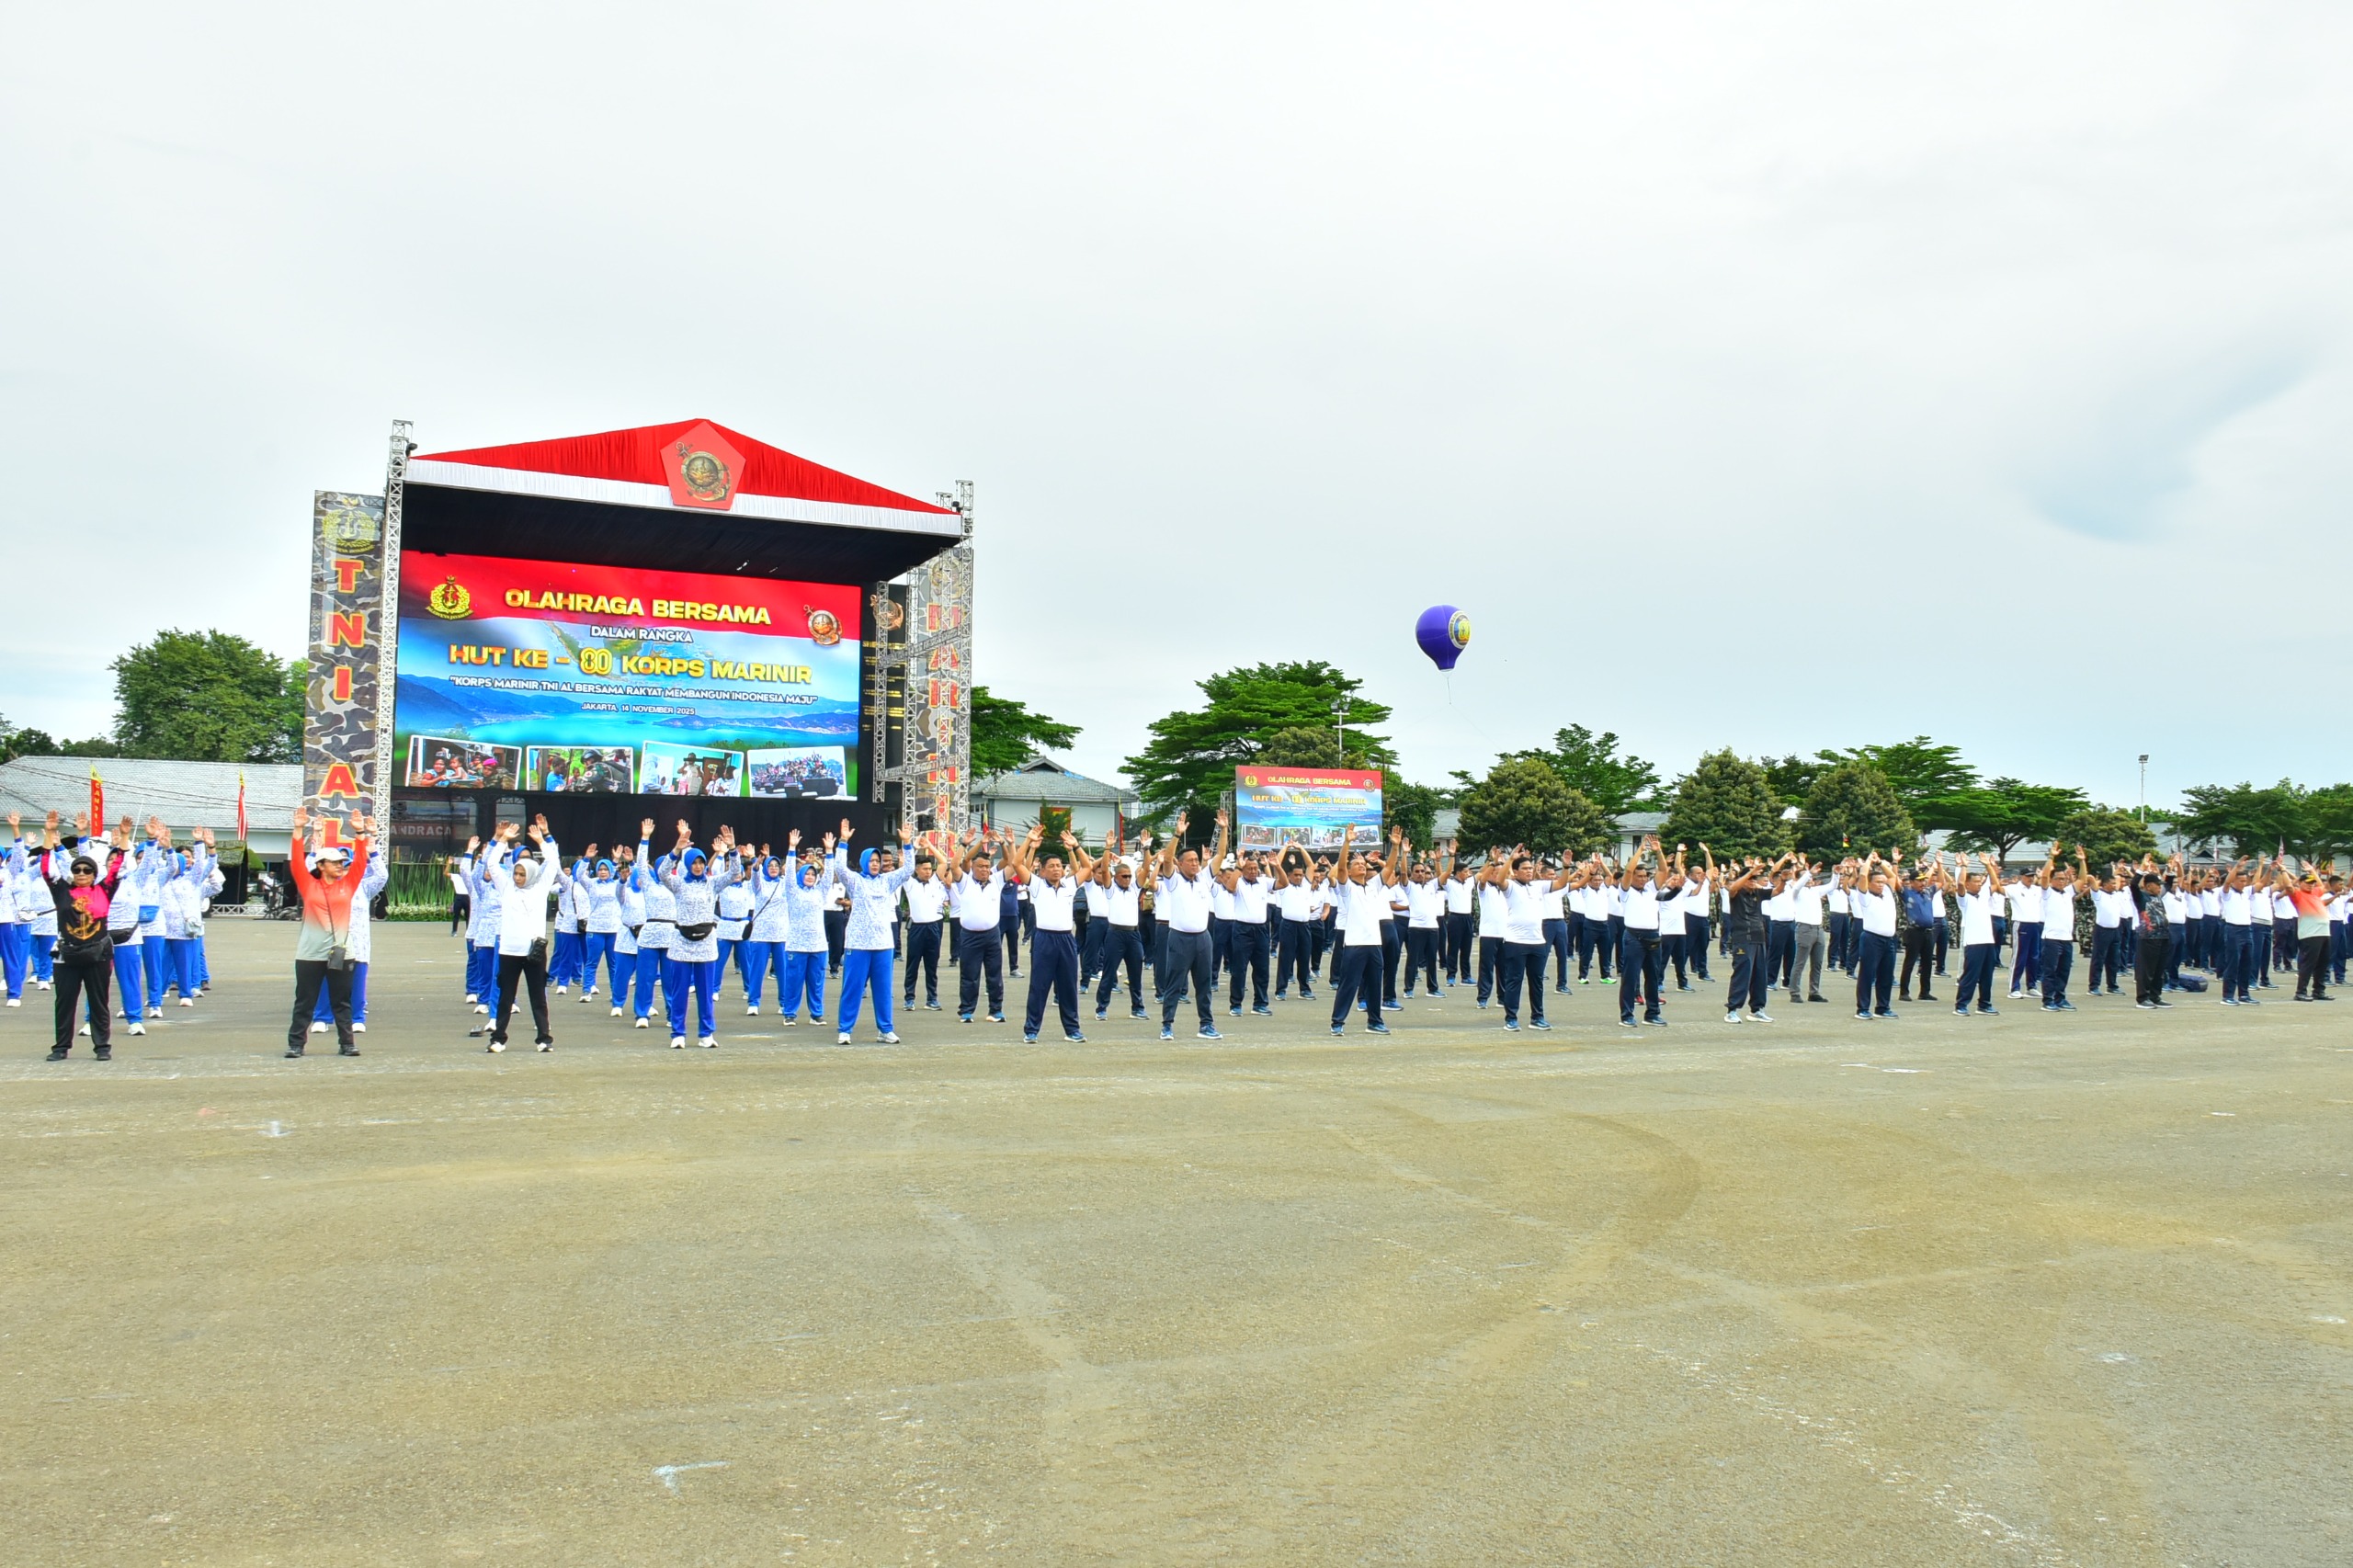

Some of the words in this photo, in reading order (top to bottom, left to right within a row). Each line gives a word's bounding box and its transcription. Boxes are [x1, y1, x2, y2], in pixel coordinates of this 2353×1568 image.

[506, 588, 644, 616] OLAHRAGA
[652, 599, 772, 625] BERSAMA
[325, 559, 365, 701] TNI
[590, 626, 637, 640] DALAM
[639, 629, 694, 643] RANGKA
[449, 644, 506, 666] HUT
[514, 648, 549, 668] KE
[580, 647, 613, 675] 80
[621, 655, 705, 678] KORPS
[712, 660, 813, 685] MARINIR
[449, 676, 492, 687] "KORPS
[494, 678, 539, 690] MARINIR
[540, 681, 558, 691] TNI
[560, 682, 574, 692] AL
[575, 683, 624, 695] BERSAMA
[626, 686, 664, 698] RAKYAT
[665, 688, 731, 700] MEMBANGUN
[732, 691, 786, 703] INDONESIA
[581, 702, 619, 712] JAKARTA,
[621, 704, 630, 712] 14
[632, 705, 674, 714] NOVEMBER
[676, 707, 695, 715] 2025
[1267, 776, 1311, 784] OLAHRAGA
[1313, 778, 1351, 786] BERSAMA
[390, 825, 451, 836] ANDRACA
